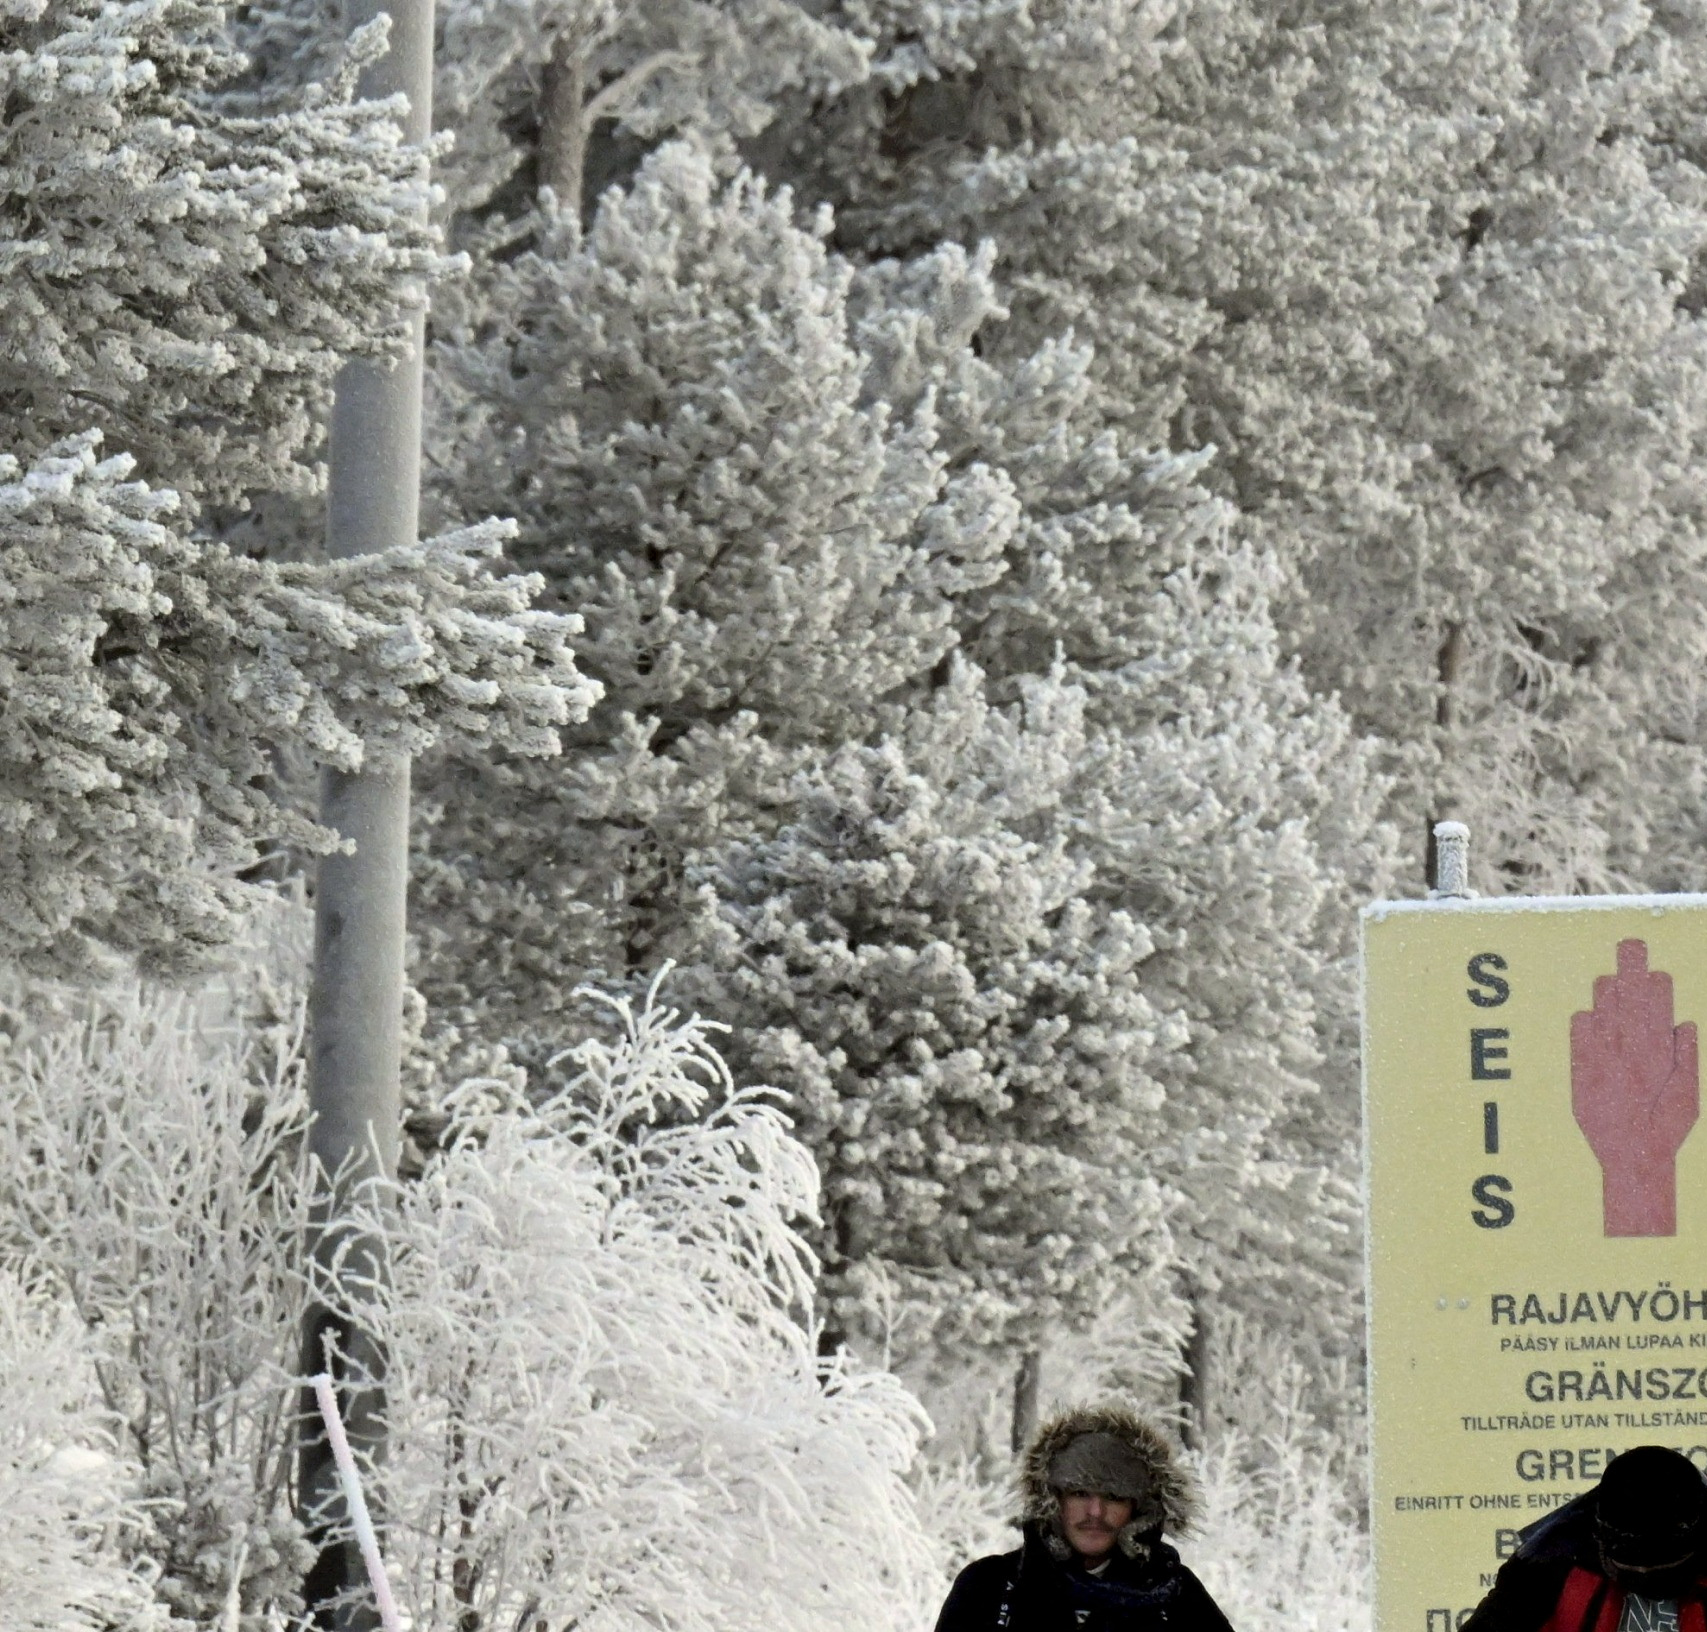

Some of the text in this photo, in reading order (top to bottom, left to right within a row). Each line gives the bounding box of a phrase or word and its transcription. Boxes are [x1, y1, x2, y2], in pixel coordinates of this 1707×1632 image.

[1466, 953, 1515, 1230] SEIS
[1500, 1334, 1558, 1351] PÄÄSY
[1627, 1334, 1684, 1349] LUPAA
[1461, 1412, 1555, 1431] TILLTRÄDE
[1562, 1414, 1609, 1429] UTAN
[1395, 1495, 1464, 1511] EINRITT
[1469, 1494, 1521, 1510] OHNE
